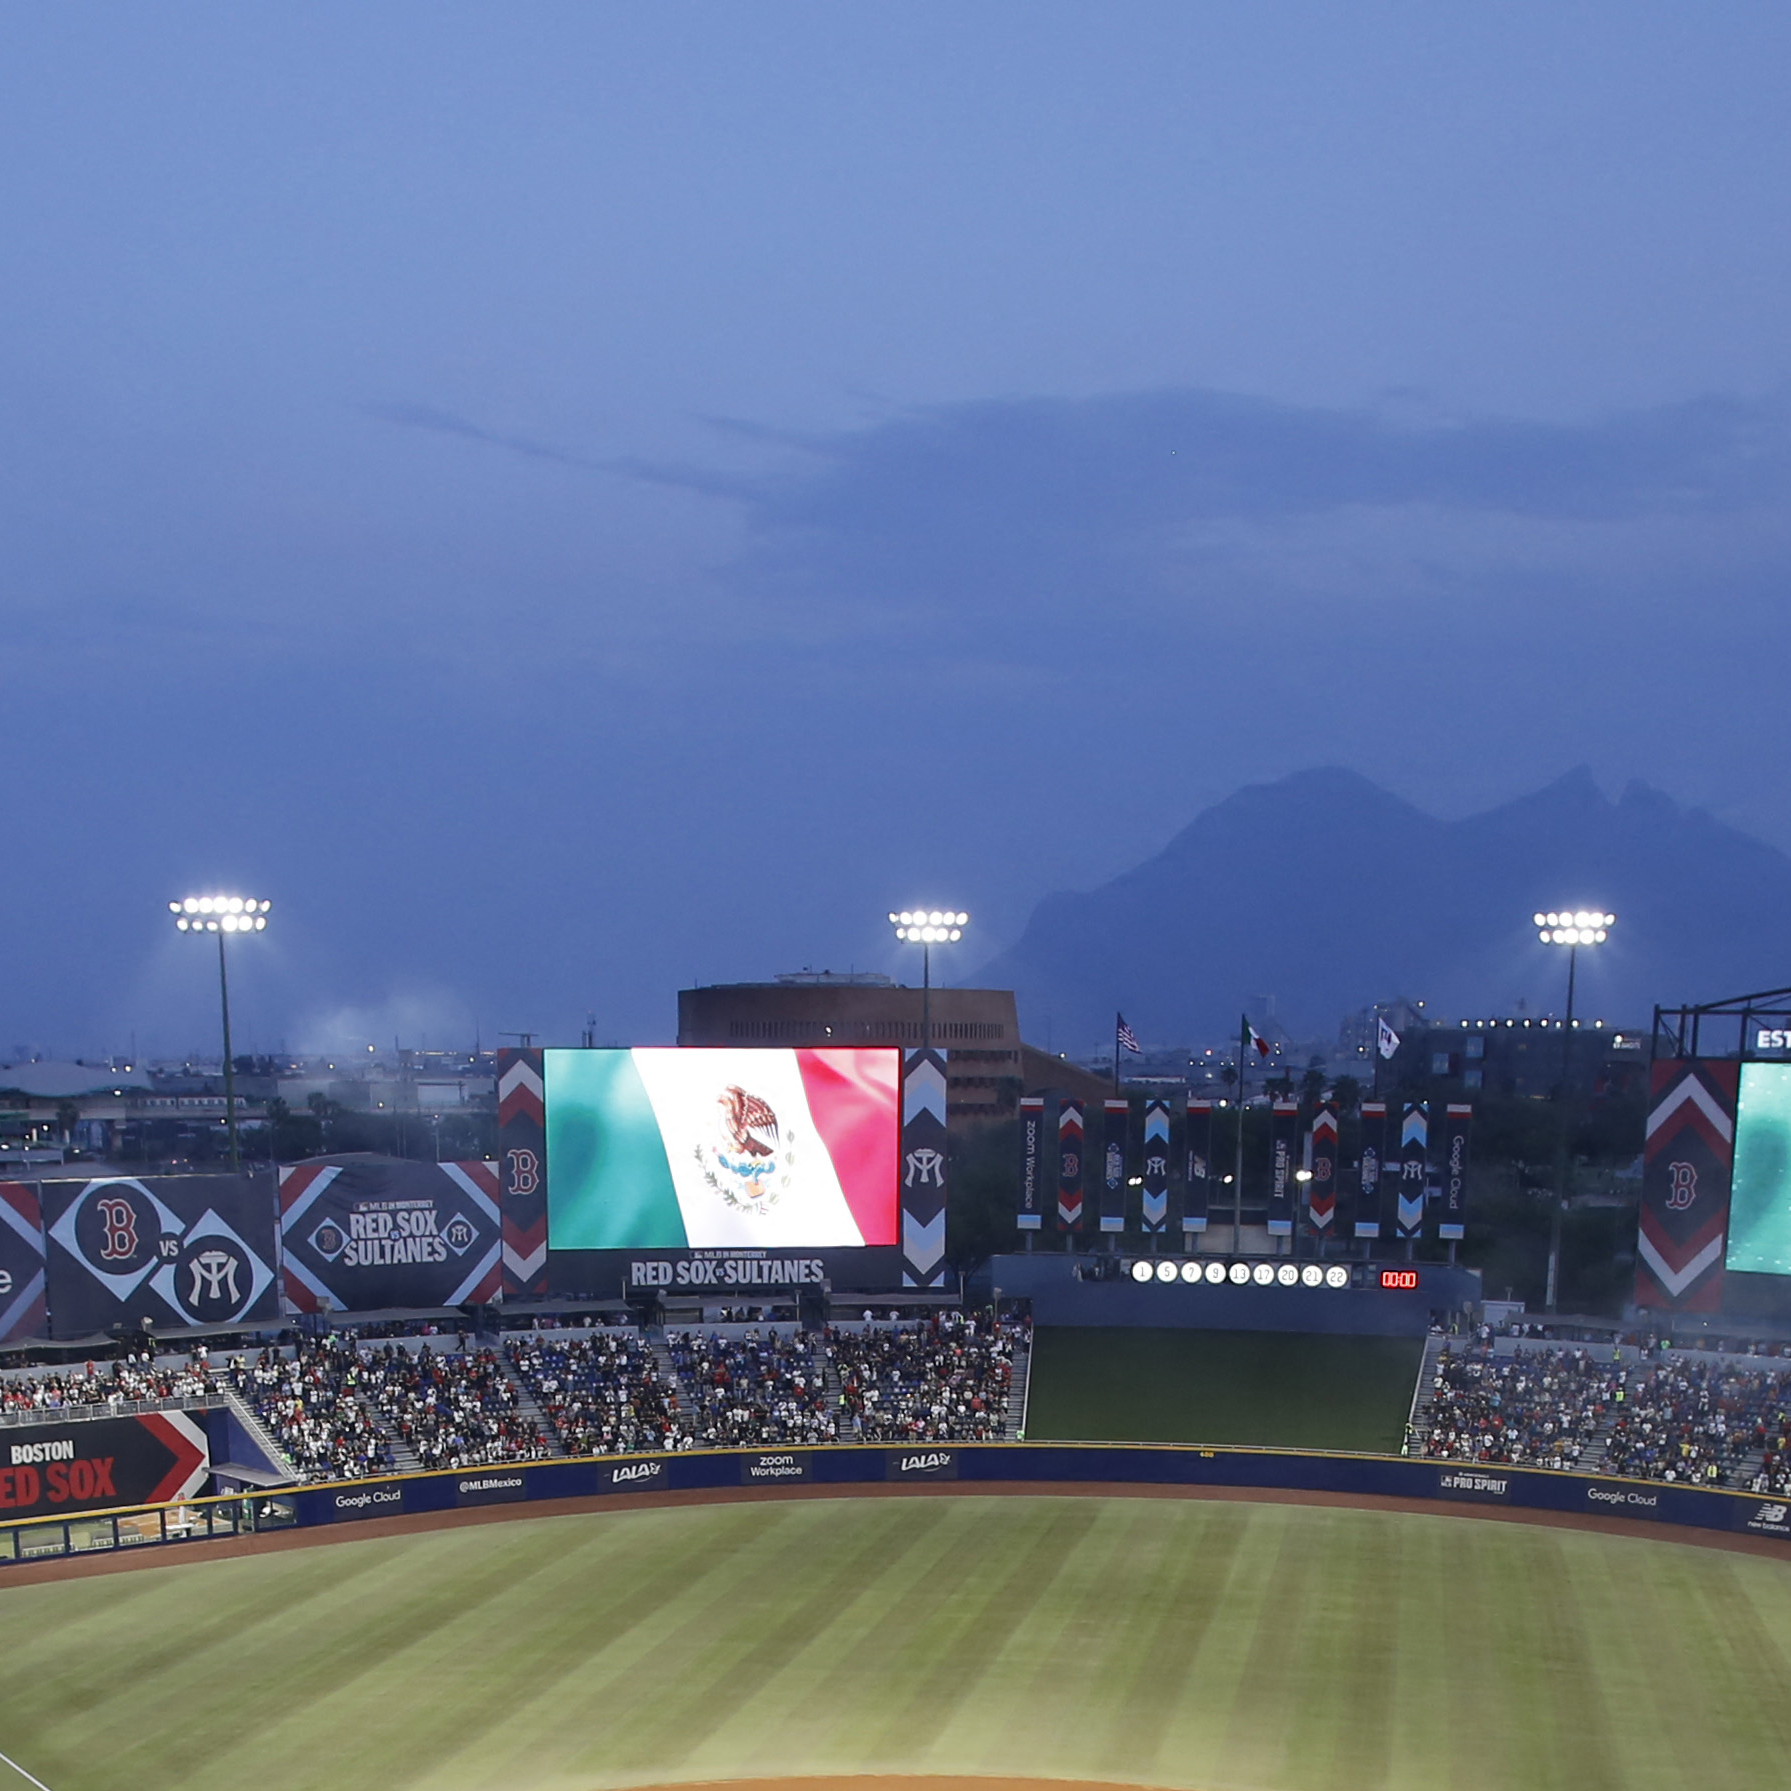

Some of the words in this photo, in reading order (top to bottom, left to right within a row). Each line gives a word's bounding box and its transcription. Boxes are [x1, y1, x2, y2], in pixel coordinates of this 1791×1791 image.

[1026, 1120, 1036, 1155] zoom
[1449, 1135, 1464, 1176] Google
[1025, 1156, 1036, 1209] Workplace
[1449, 1178, 1462, 1210] Cloud
[349, 1212, 393, 1239] RED
[396, 1210, 438, 1238] SOX
[159, 1240, 179, 1257] VS
[343, 1236, 448, 1267] SULTANES
[631, 1261, 673, 1286] RED
[676, 1260, 719, 1285] SOX
[723, 1259, 824, 1284] SULTANES
[1212, 1267, 1219, 1279] 9
[1233, 1268, 1246, 1279] 13
[1258, 1269, 1270, 1280] 17
[1282, 1269, 1295, 1281] 20
[1305, 1270, 1318, 1282] 21
[1329, 1271, 1344, 1283] 22
[1381, 1271, 1417, 1288] 00:00
[10, 1440, 74, 1465] BOSTON
[759, 1455, 794, 1466] zoom
[901, 1453, 940, 1471] LALA
[46, 1456, 117, 1504] SOX
[612, 1463, 650, 1483] LALA
[750, 1465, 802, 1478] Workplace
[459, 1477, 522, 1493] @MLBMexico
[1453, 1476, 1473, 1490] PRO
[1474, 1478, 1508, 1492] SPIRIT
[335, 1493, 372, 1508] Google
[373, 1489, 401, 1502] Cloud
[1587, 1488, 1626, 1504] Google
[1627, 1492, 1657, 1506] Cloud
[1747, 1520, 1762, 1529] new
[1762, 1522, 1790, 1533] balance
